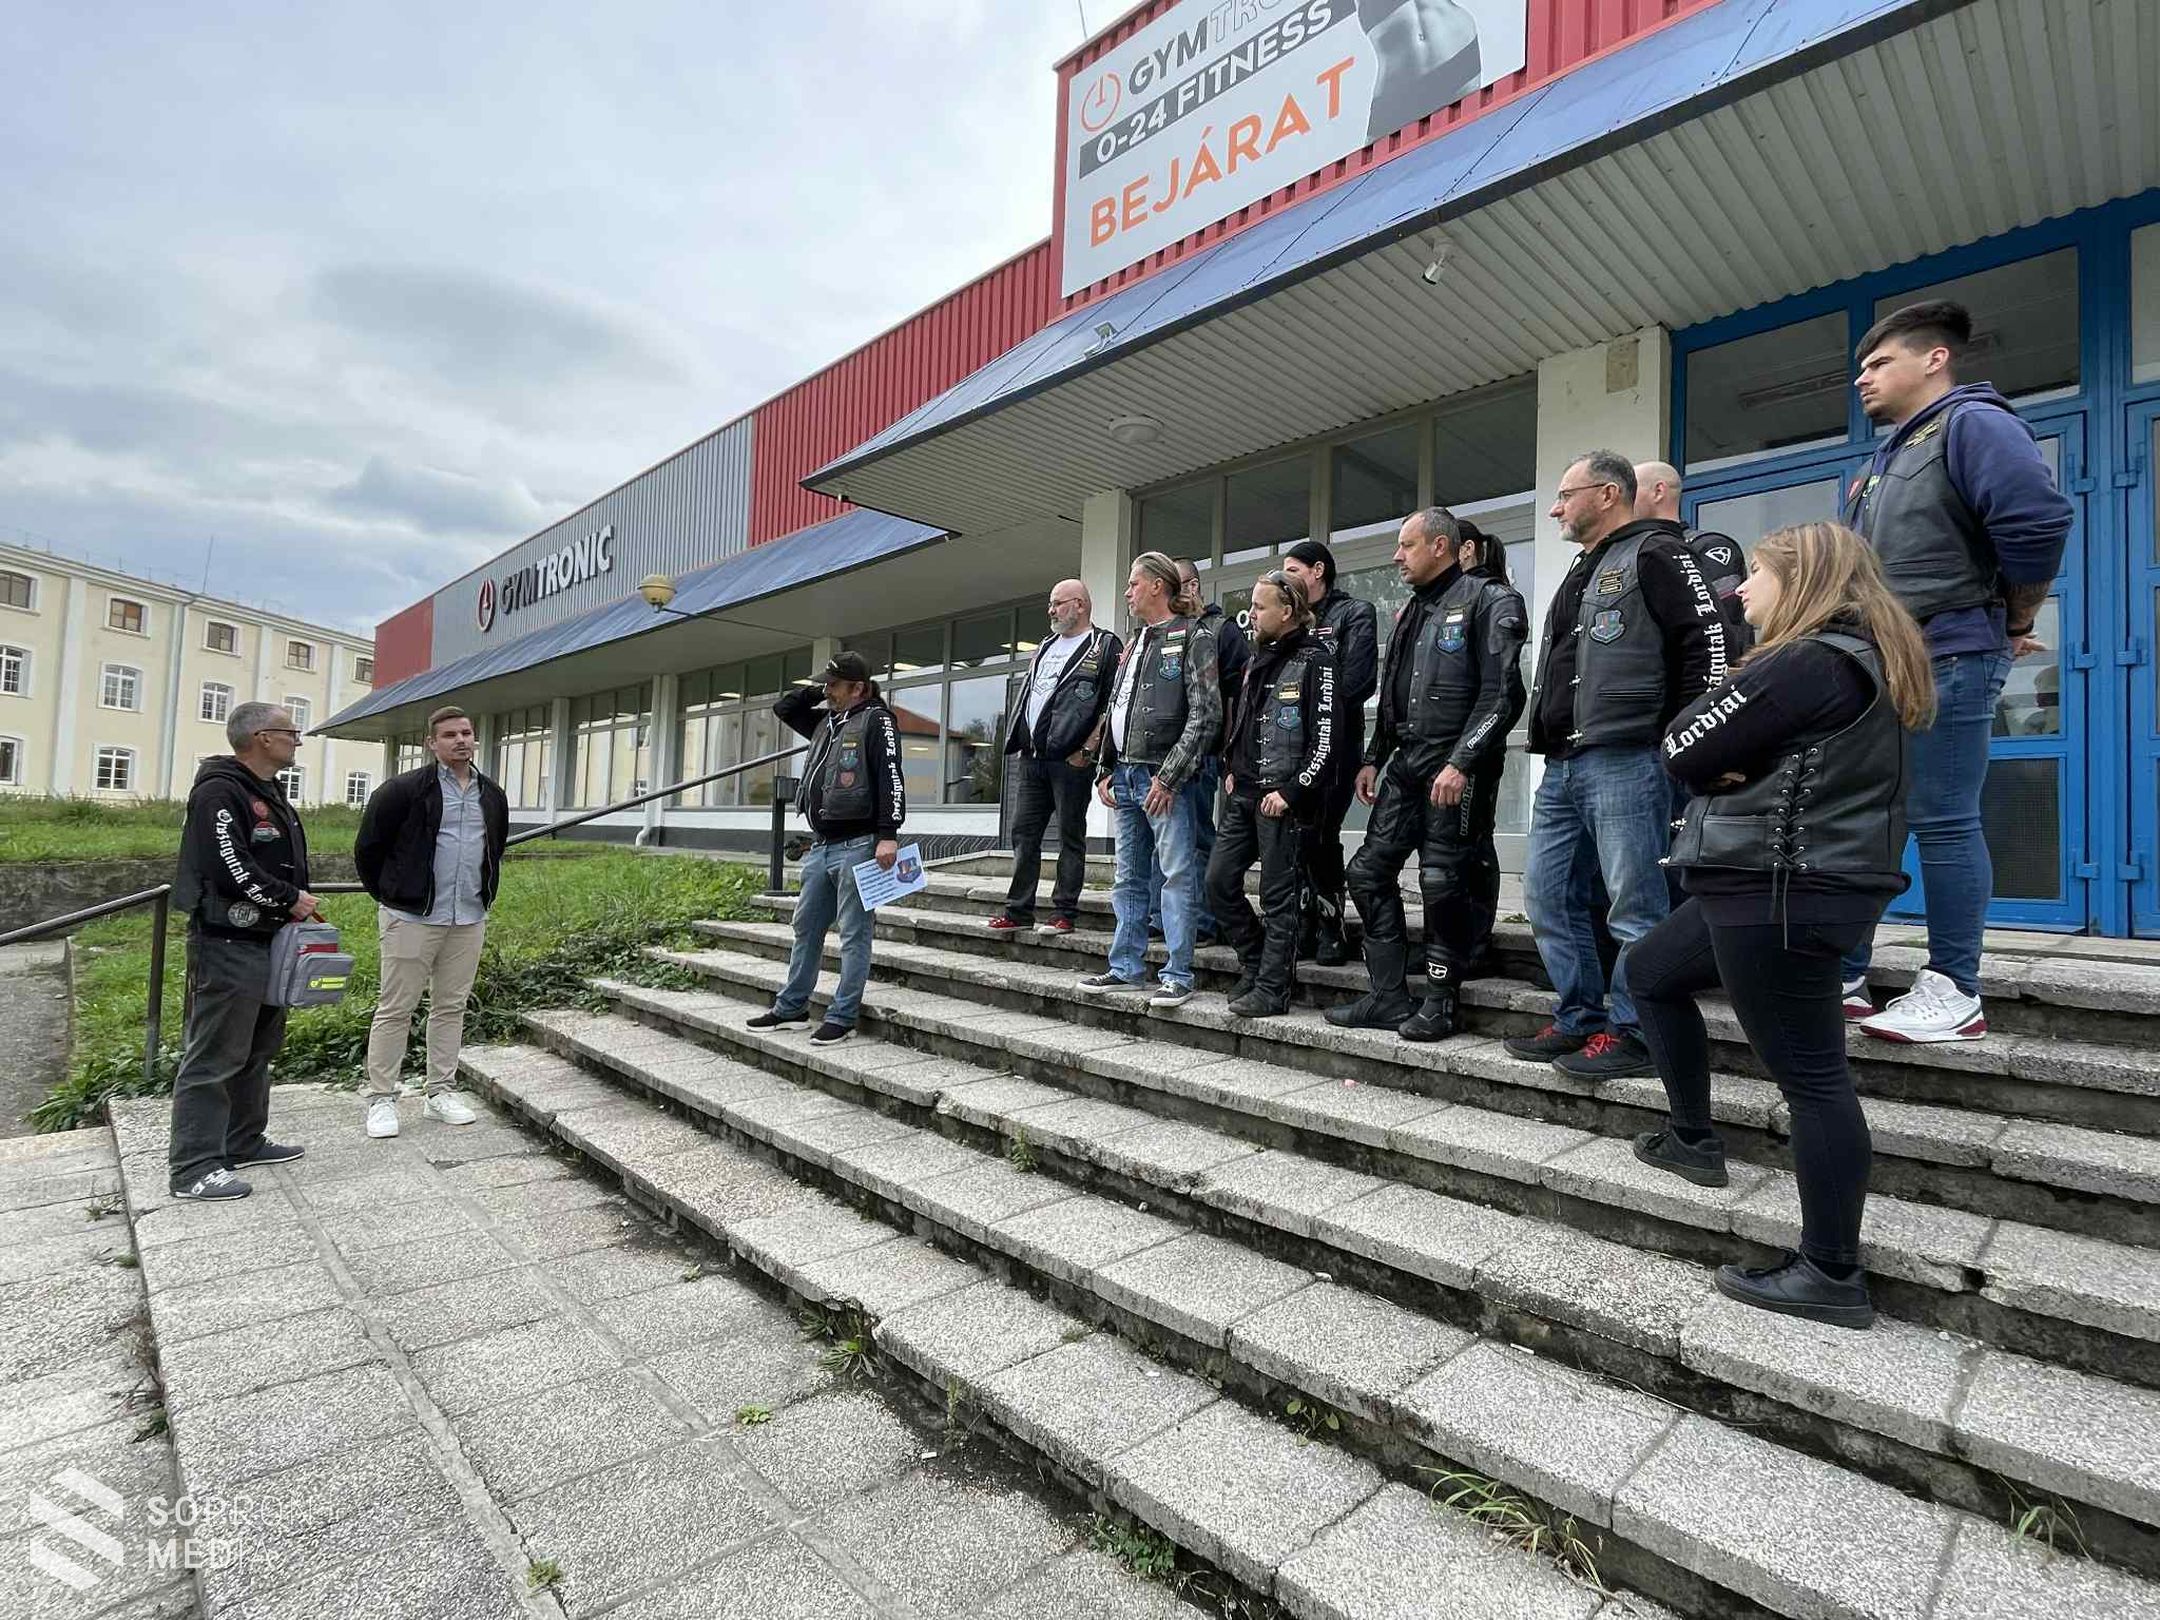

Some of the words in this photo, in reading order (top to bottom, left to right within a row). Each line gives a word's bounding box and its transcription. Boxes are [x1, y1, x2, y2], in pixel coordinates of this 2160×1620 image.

[1096, 98, 1168, 164] 0-24
[1177, 0, 1333, 116] FITNESS
[1090, 56, 1356, 248] BEJÁRAT
[501, 525, 615, 616] GYMTRONIC
[1672, 554, 1718, 617] Lordjai
[1664, 684, 1748, 760] Lordjai
